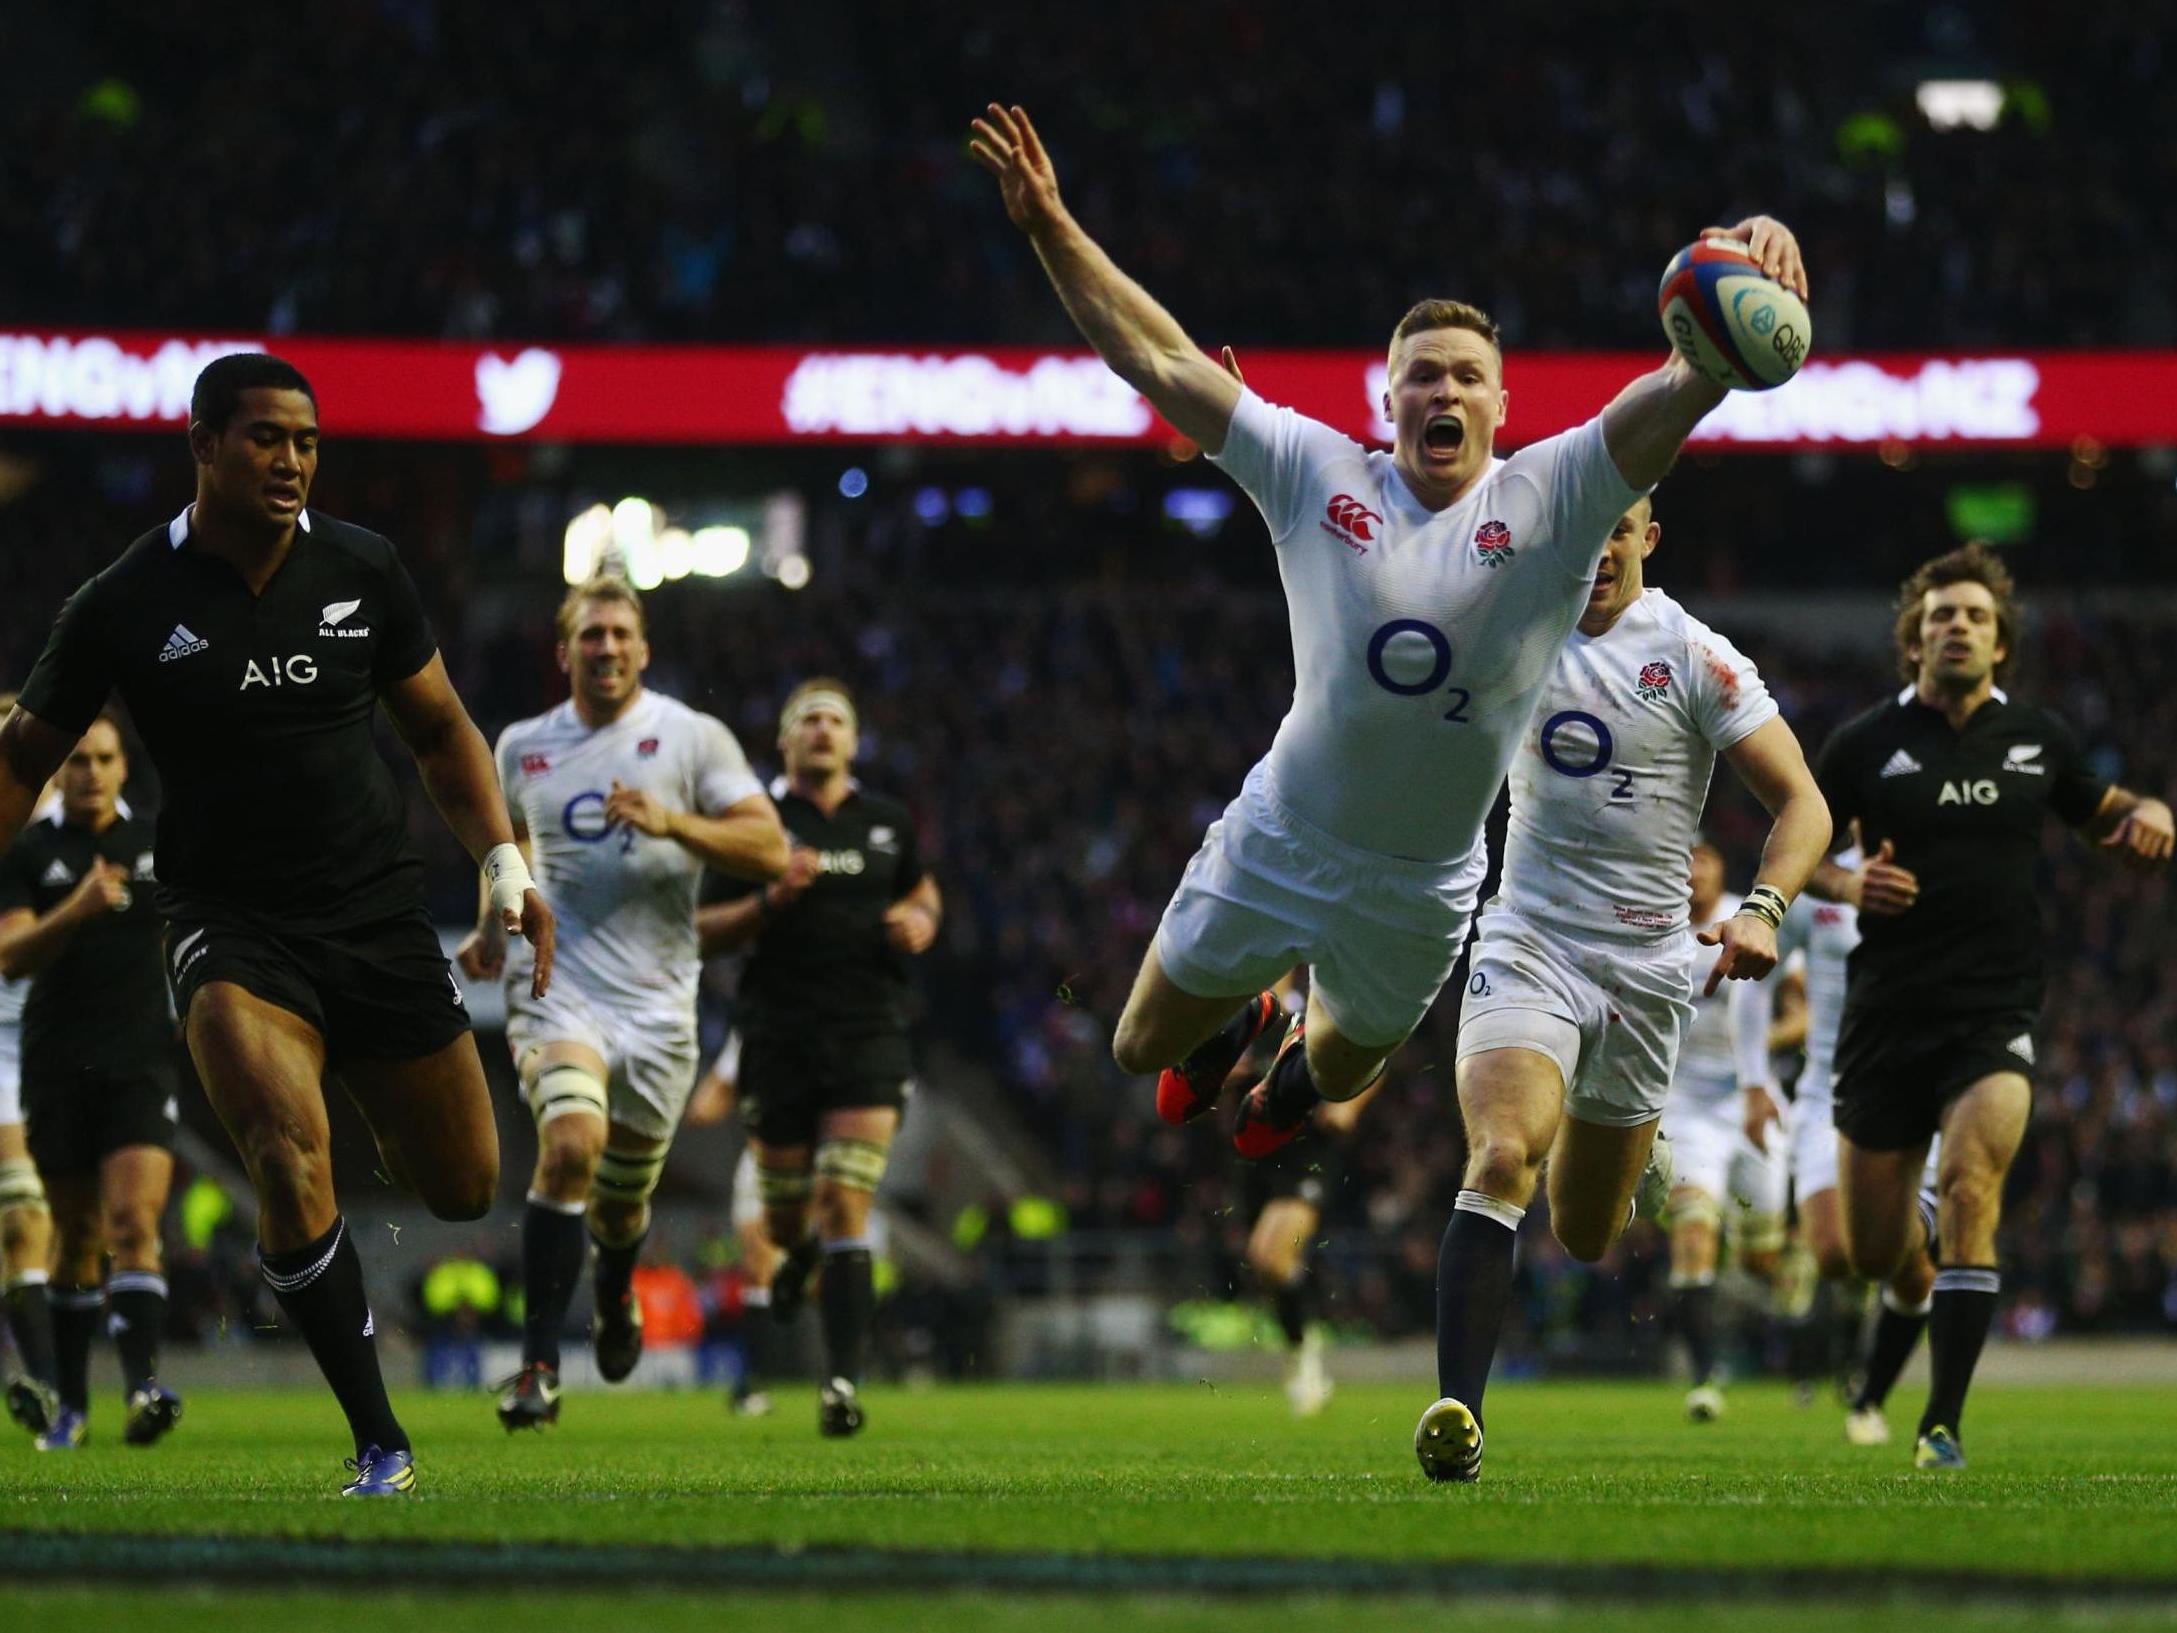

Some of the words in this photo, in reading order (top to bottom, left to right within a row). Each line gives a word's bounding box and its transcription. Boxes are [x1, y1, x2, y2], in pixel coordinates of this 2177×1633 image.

[319, 628, 335, 637] ALL
[337, 629, 369, 637] BLACKS
[159, 638, 209, 662] adidas
[239, 654, 318, 691] AIG
[1937, 779, 1999, 806] AIG
[1470, 971, 1491, 996] O2
